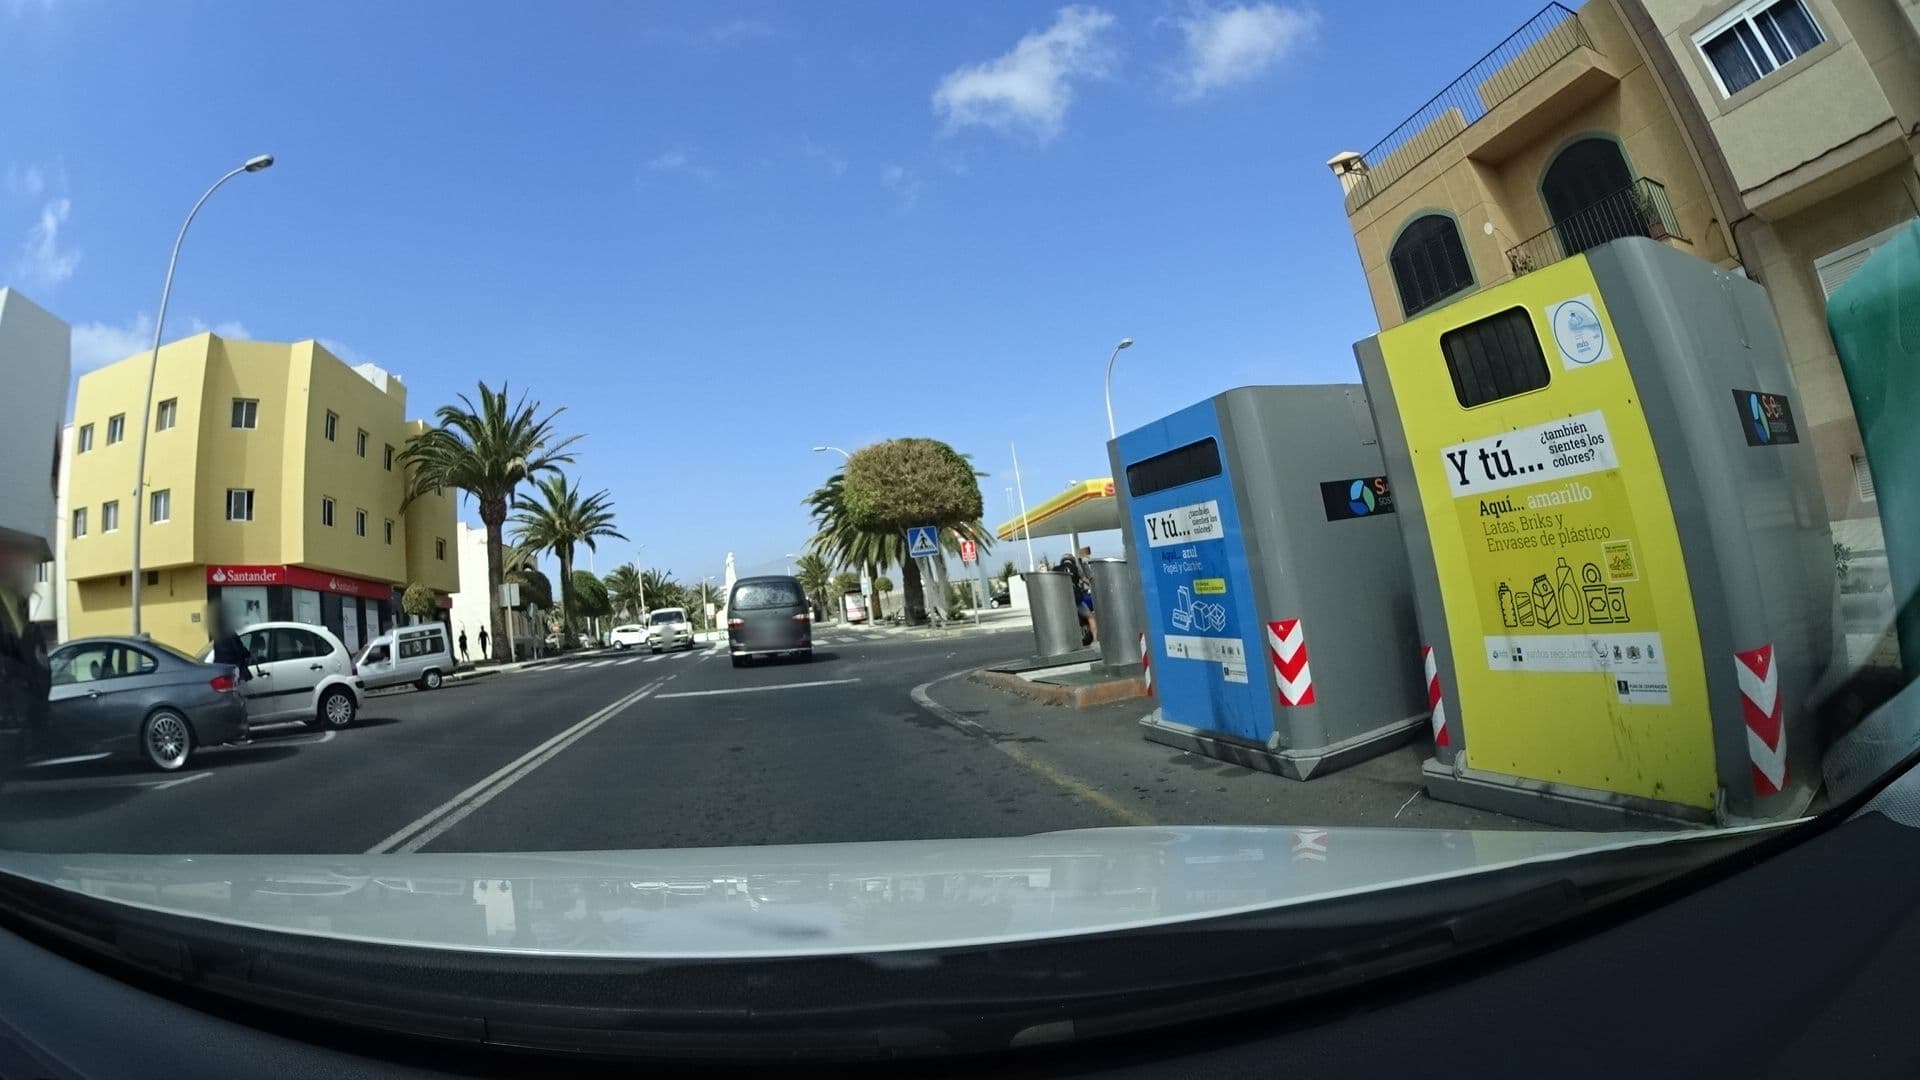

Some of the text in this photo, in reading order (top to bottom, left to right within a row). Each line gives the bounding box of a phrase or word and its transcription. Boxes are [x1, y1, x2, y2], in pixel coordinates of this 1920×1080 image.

[1540, 422, 1588, 445] ¿también
[1548, 430, 1605, 454] sientes los
[1446, 440, 1544, 485] Y tú...
[1552, 449, 1596, 468] colores?
[1479, 482, 1593, 519] Aquí... amarillo
[1147, 513, 1191, 540] Y tú...
[1482, 513, 1564, 536] Latas, Briks y
[1486, 534, 1538, 553] Envases
[1540, 531, 1556, 547] de
[1559, 523, 1612, 549] plástico
[1182, 545, 1198, 559] azul
[227, 569, 277, 582] Santander
